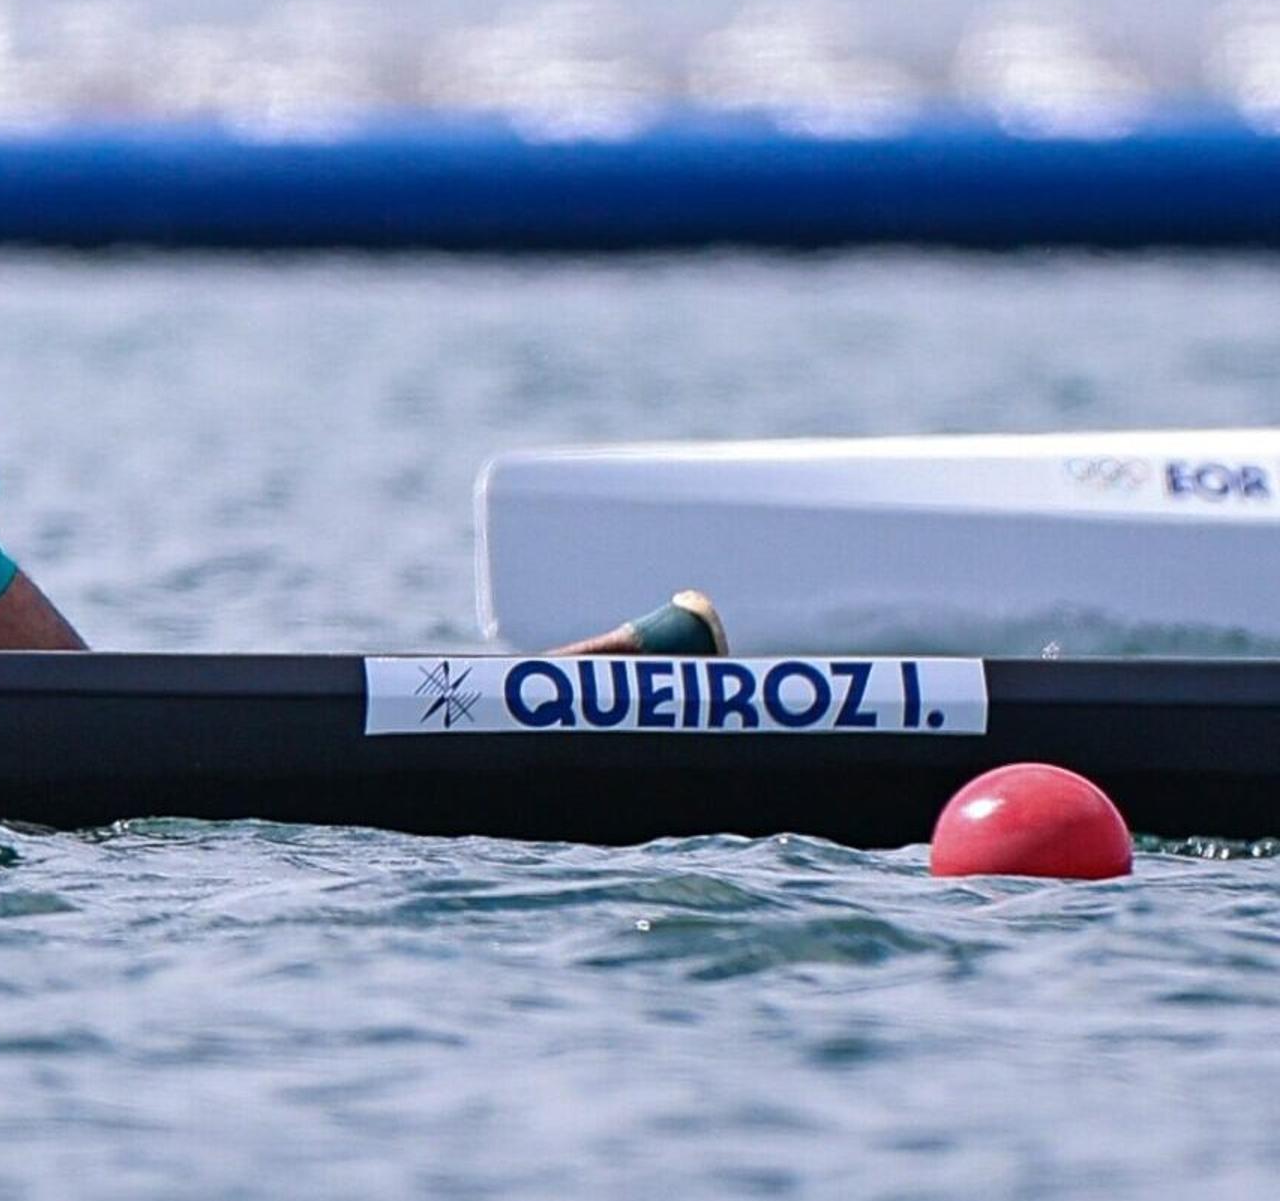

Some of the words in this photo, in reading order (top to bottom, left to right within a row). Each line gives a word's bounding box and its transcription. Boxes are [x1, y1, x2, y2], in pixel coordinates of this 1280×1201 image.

[1166, 460, 1269, 501] EOR
[504, 660, 877, 728] QUEIROZ
[901, 661, 945, 728] I.
